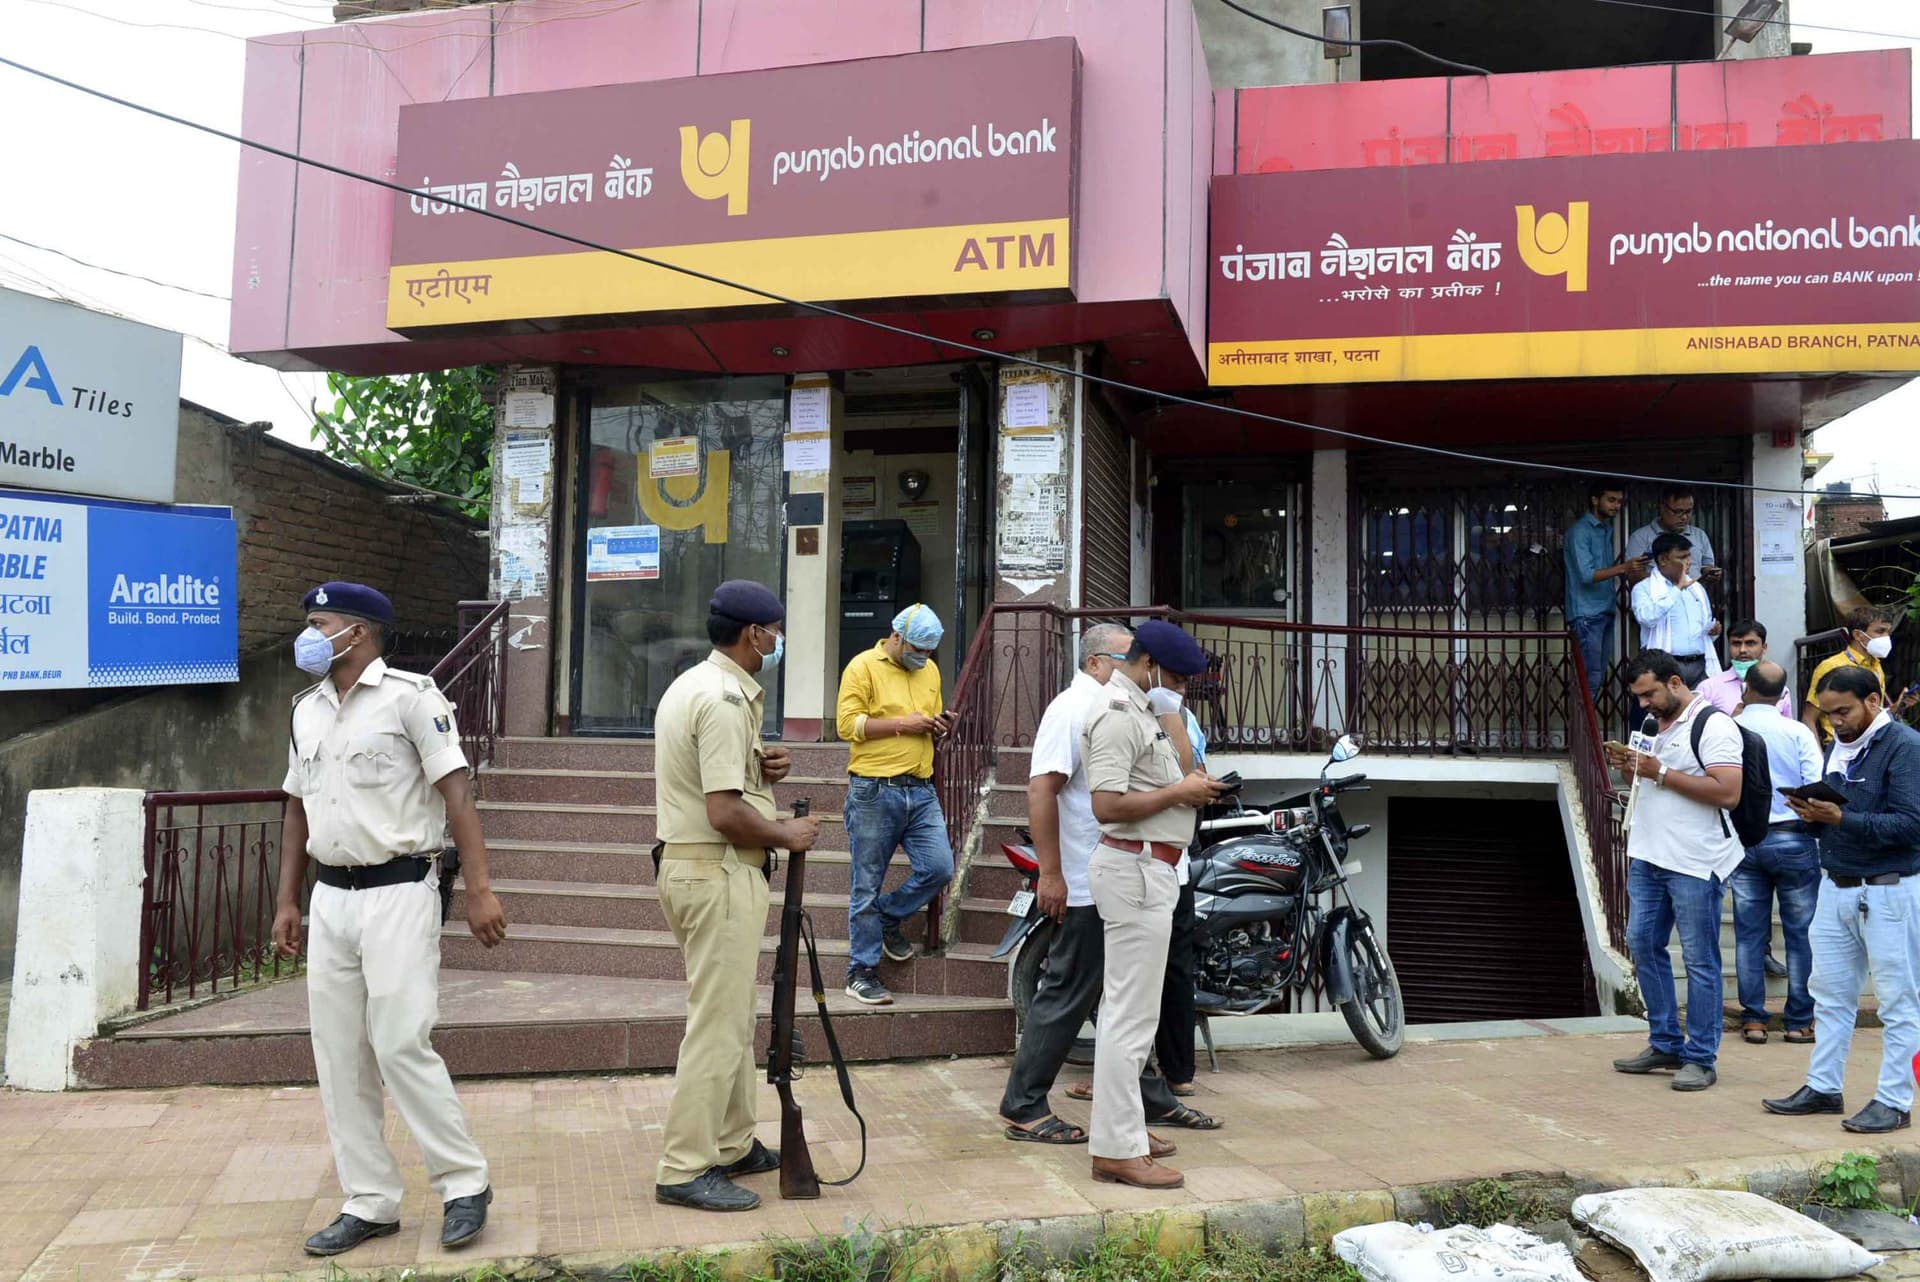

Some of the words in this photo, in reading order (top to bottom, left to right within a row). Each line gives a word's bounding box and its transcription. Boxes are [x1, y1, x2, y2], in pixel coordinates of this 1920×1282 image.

[772, 136, 865, 186] punjab
[868, 124, 983, 167] national
[987, 118, 1057, 157] bank
[495, 161, 593, 211] नैशनल
[604, 153, 654, 200] बैंक
[953, 232, 1055, 273] ATM
[1219, 244, 1311, 282] पंजाब
[1320, 231, 1433, 280] नैशनल
[1446, 227, 1502, 272] बैंक
[1609, 221, 1713, 265] punjab
[1716, 219, 1843, 252] national
[405, 268, 493, 308] एटीएम
[1397, 286, 1425, 300] का
[1430, 281, 1485, 299] प्रतीक
[1734, 274, 1773, 286] name
[1774, 274, 1802, 288] you
[1804, 273, 1829, 284] can
[1832, 270, 1875, 284] BANK
[1876, 272, 1914, 286] upon
[1218, 349, 1290, 366] अनीसाबाद
[1343, 349, 1381, 362] पटना
[1686, 335, 1783, 350] ANISHABAD
[1787, 335, 1862, 350] BRANCH,
[1867, 334, 1920, 348] PATNA
[72, 386, 134, 418] Tiles
[0, 441, 75, 473] Marble
[108, 612, 143, 625] Build.
[145, 612, 179, 625] Bond.
[181, 612, 221, 625] Protect
[3, 670, 18, 680] PNB
